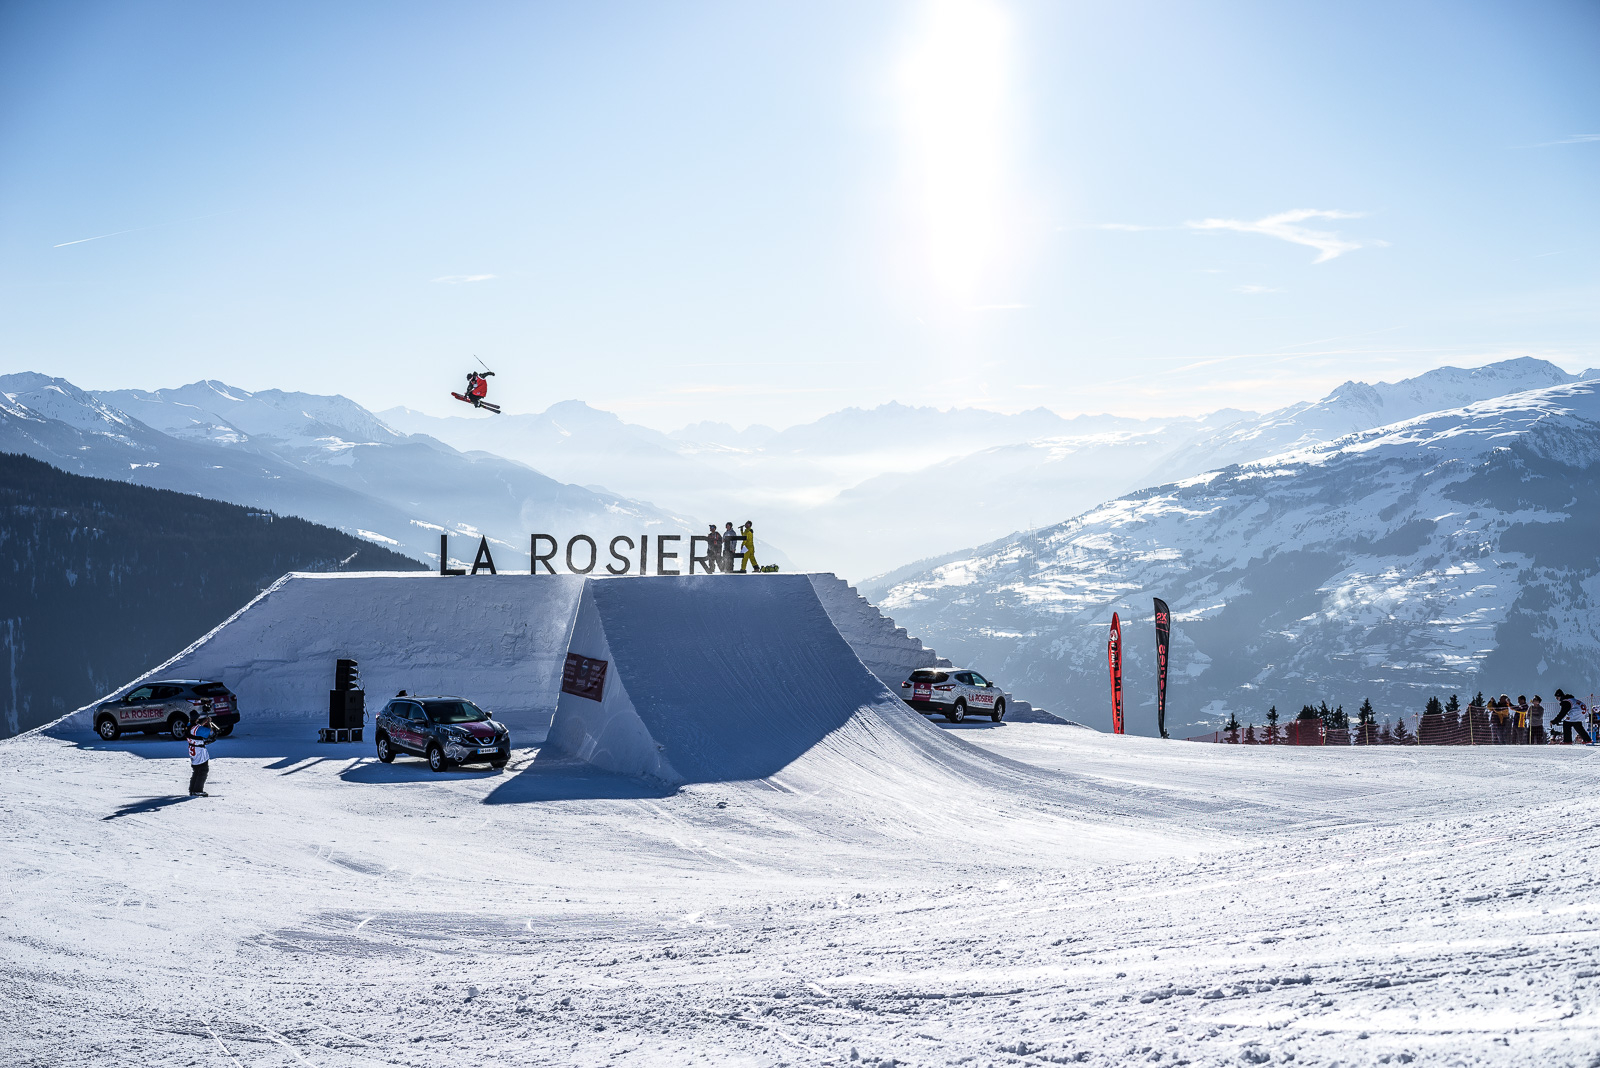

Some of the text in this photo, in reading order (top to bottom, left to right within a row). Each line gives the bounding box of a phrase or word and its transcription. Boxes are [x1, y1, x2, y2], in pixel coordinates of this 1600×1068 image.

[440, 534, 748, 576] LA ROSIERE
[968, 693, 975, 702] LA
[119, 708, 164, 719] LA ROSIERE
